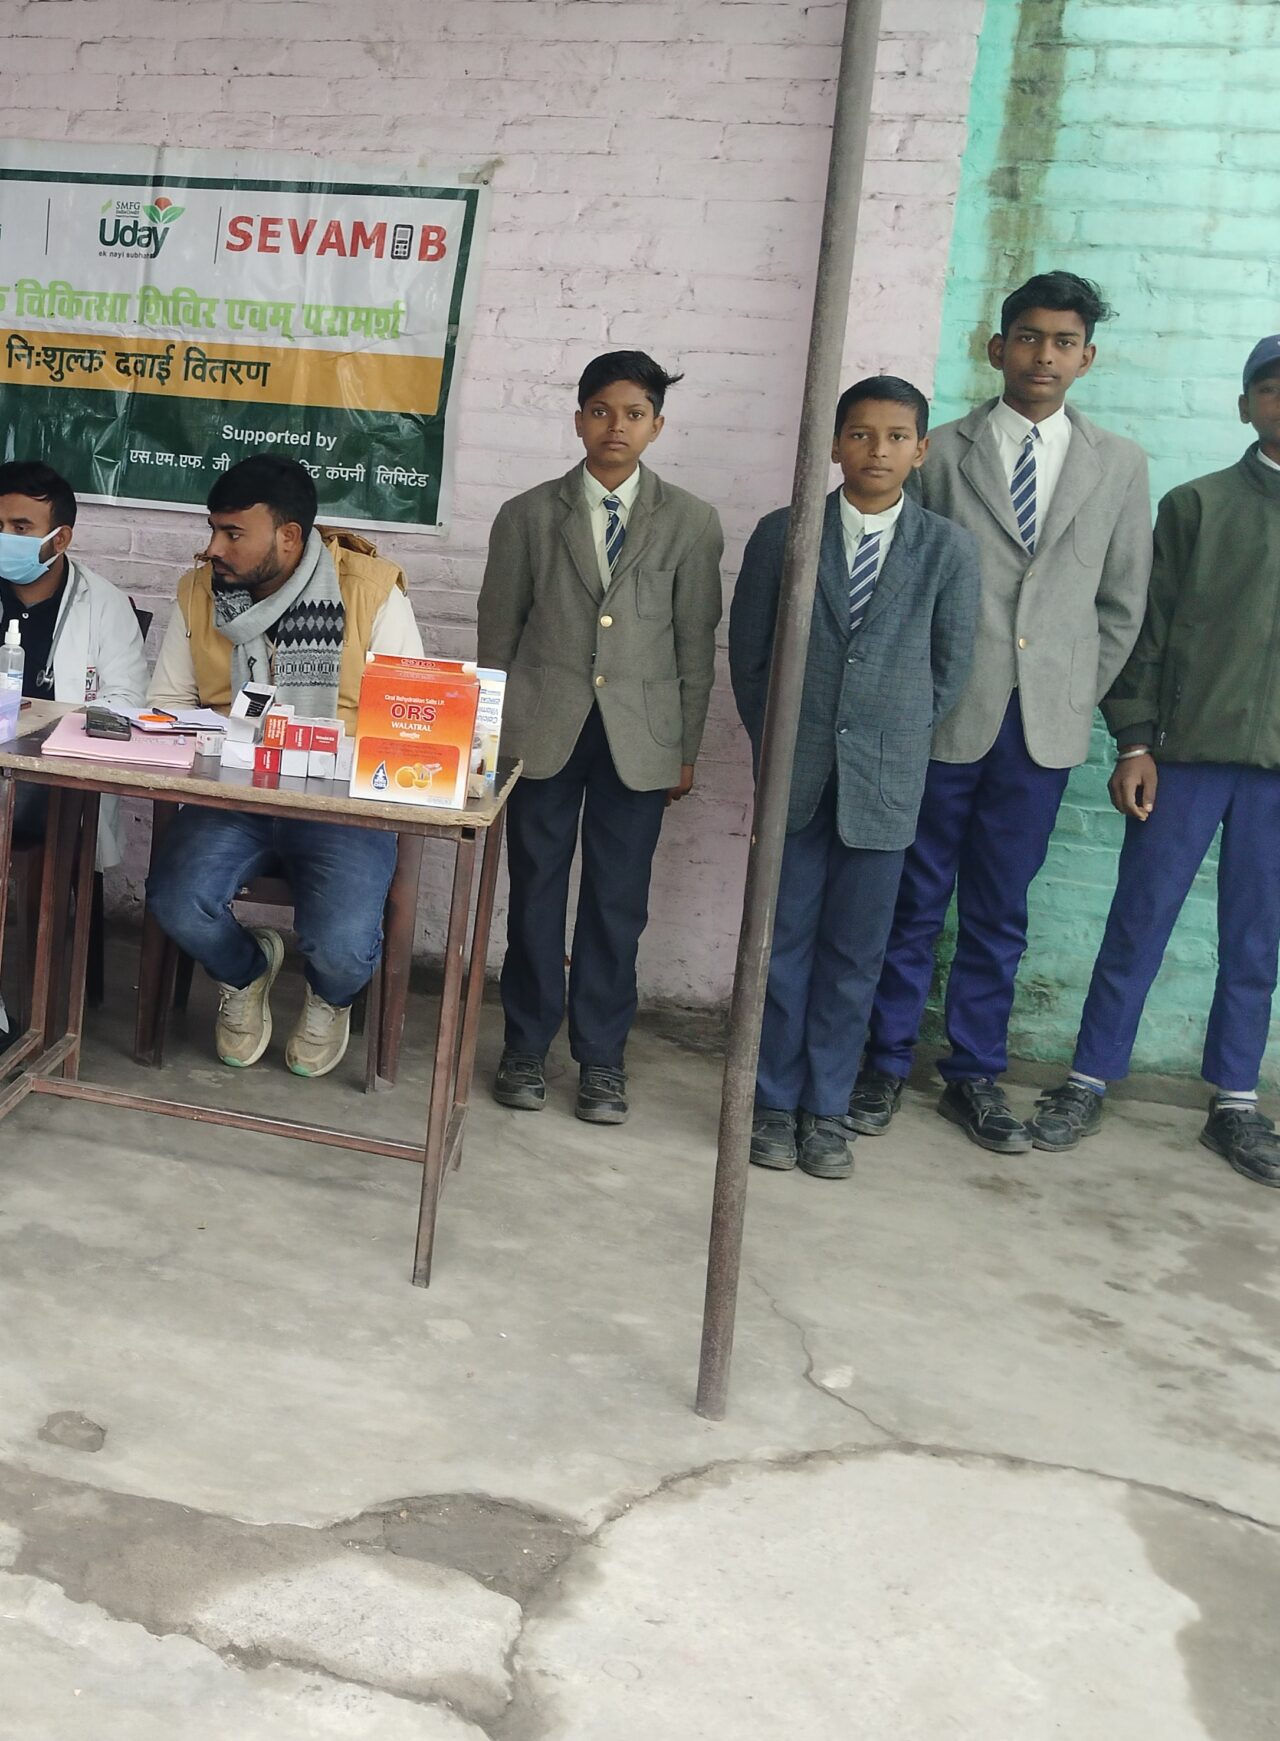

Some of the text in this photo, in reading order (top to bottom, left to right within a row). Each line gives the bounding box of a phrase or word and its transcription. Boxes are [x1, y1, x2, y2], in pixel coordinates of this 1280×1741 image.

[115, 200, 141, 210] SMFG
[99, 218, 170, 259] Uday
[137, 284, 219, 328] शिविर
[115, 344, 176, 386] दवाई
[183, 346, 271, 387] वितरण
[221, 424, 337, 451] Supported by
[326, 462, 366, 483] कंपनी
[375, 466, 429, 488] लिमिटेड
[391, 702, 436, 722] ORS
[391, 721, 432, 732] WALATRAL
